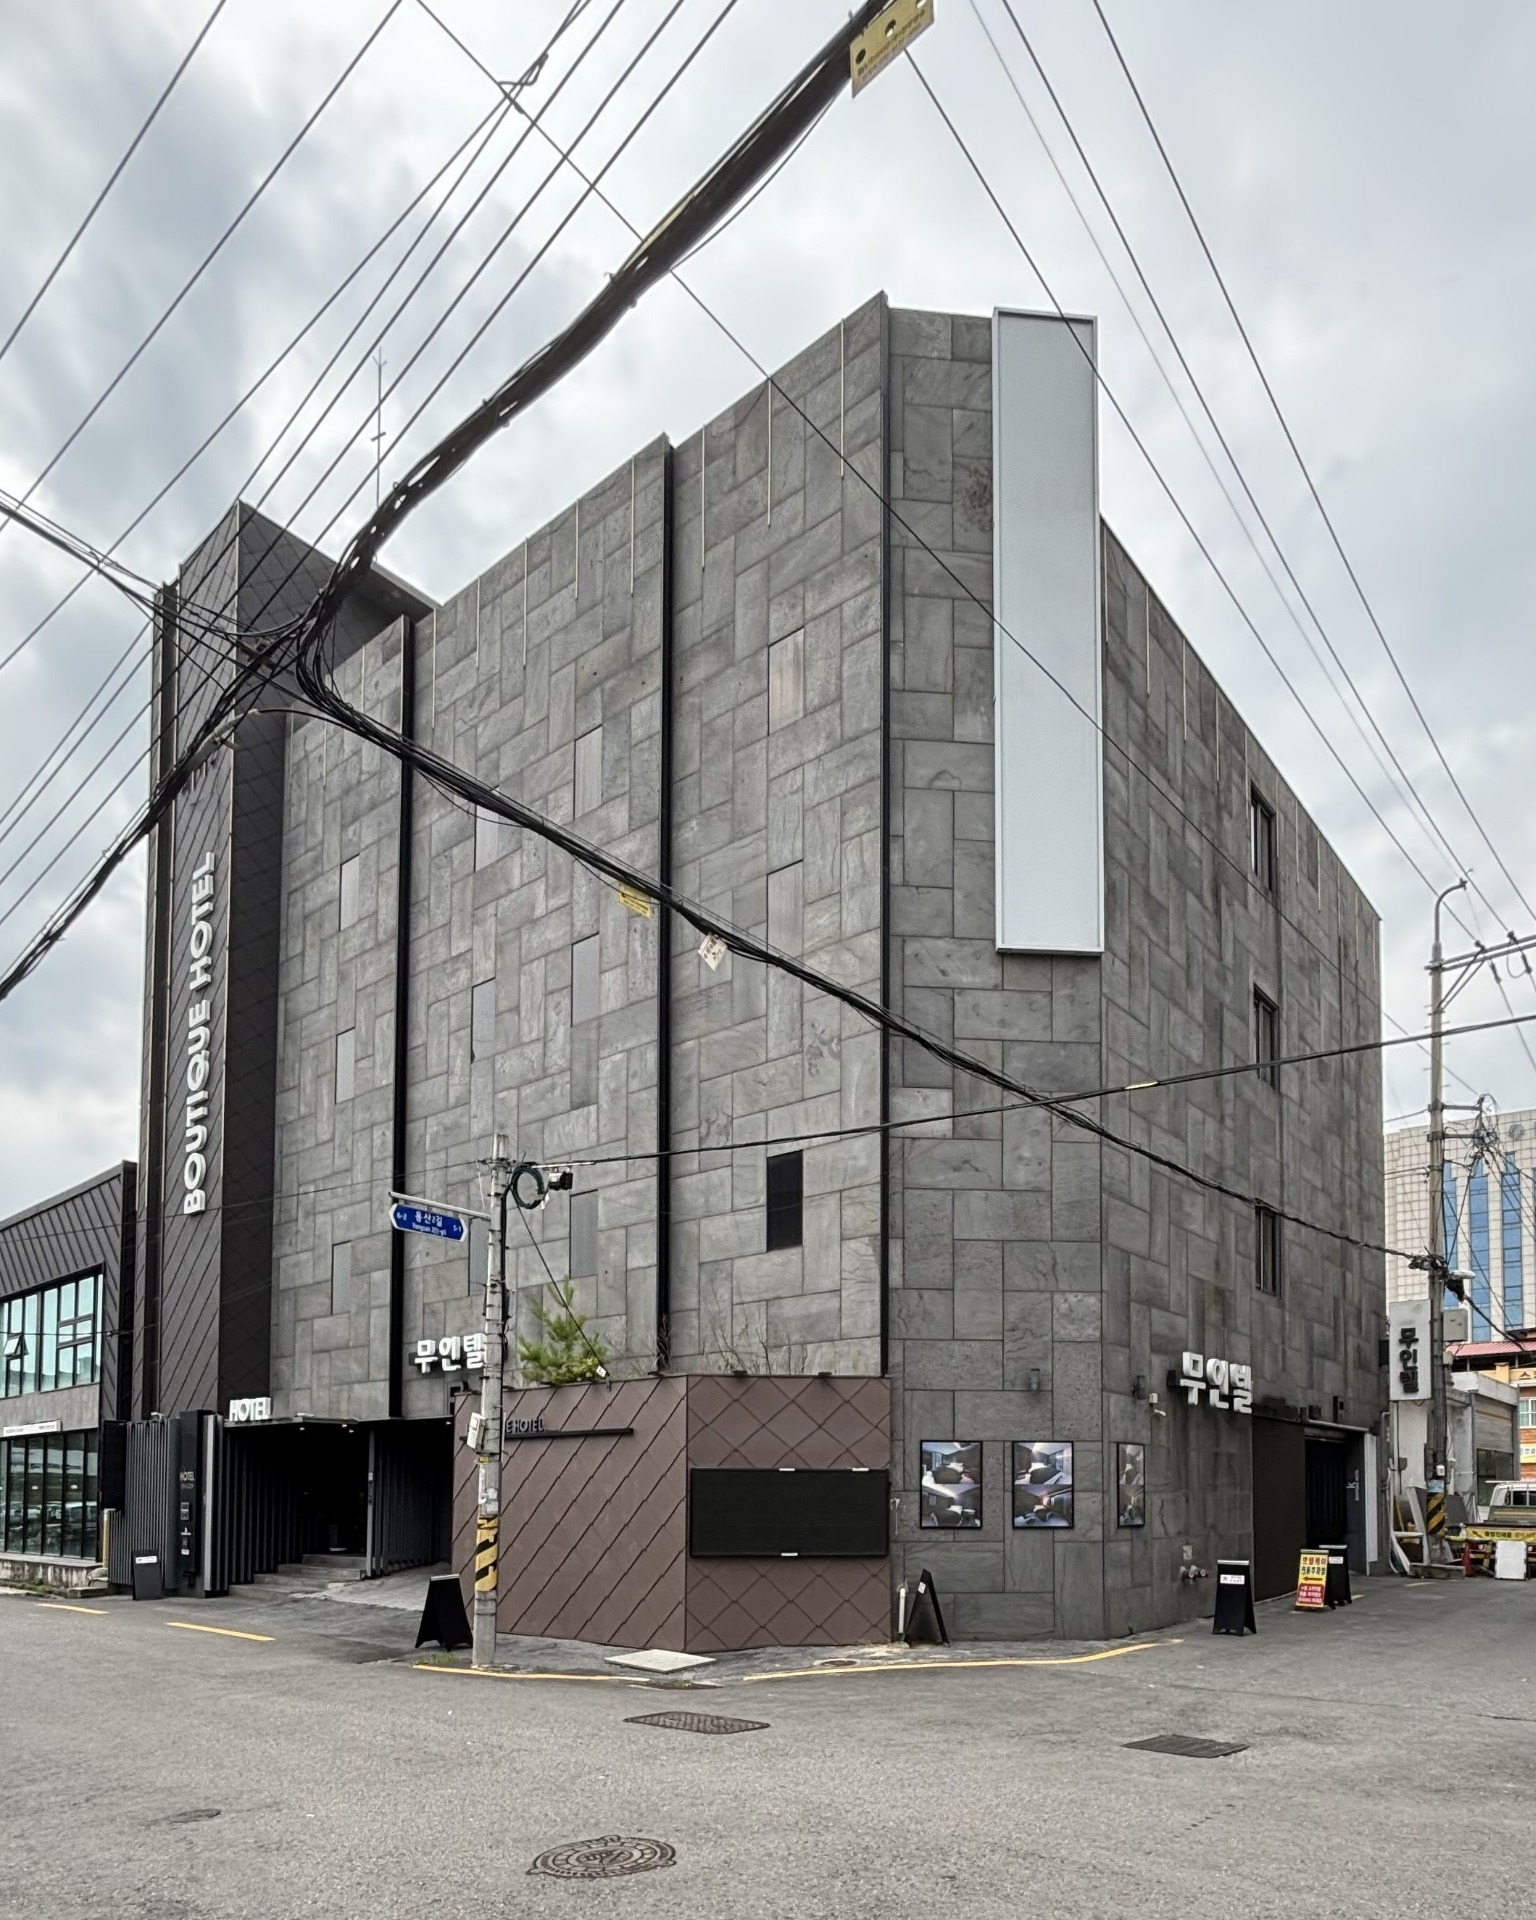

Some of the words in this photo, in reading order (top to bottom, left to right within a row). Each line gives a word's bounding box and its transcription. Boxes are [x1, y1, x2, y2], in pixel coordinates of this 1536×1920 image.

[189, 852, 215, 992] HOTEL
[183, 1000, 211, 1216] BOUTIQUE
[415, 1211, 442, 1227] 용산2길
[414, 1332, 486, 1374] 무인텔
[1398, 1327, 1420, 1394] 무인텔
[1180, 1351, 1253, 1414] 무인텔
[229, 1397, 272, 1422] HOTEL
[515, 1418, 545, 1433] HOTEL
[180, 1471, 195, 1481] HOTEL
